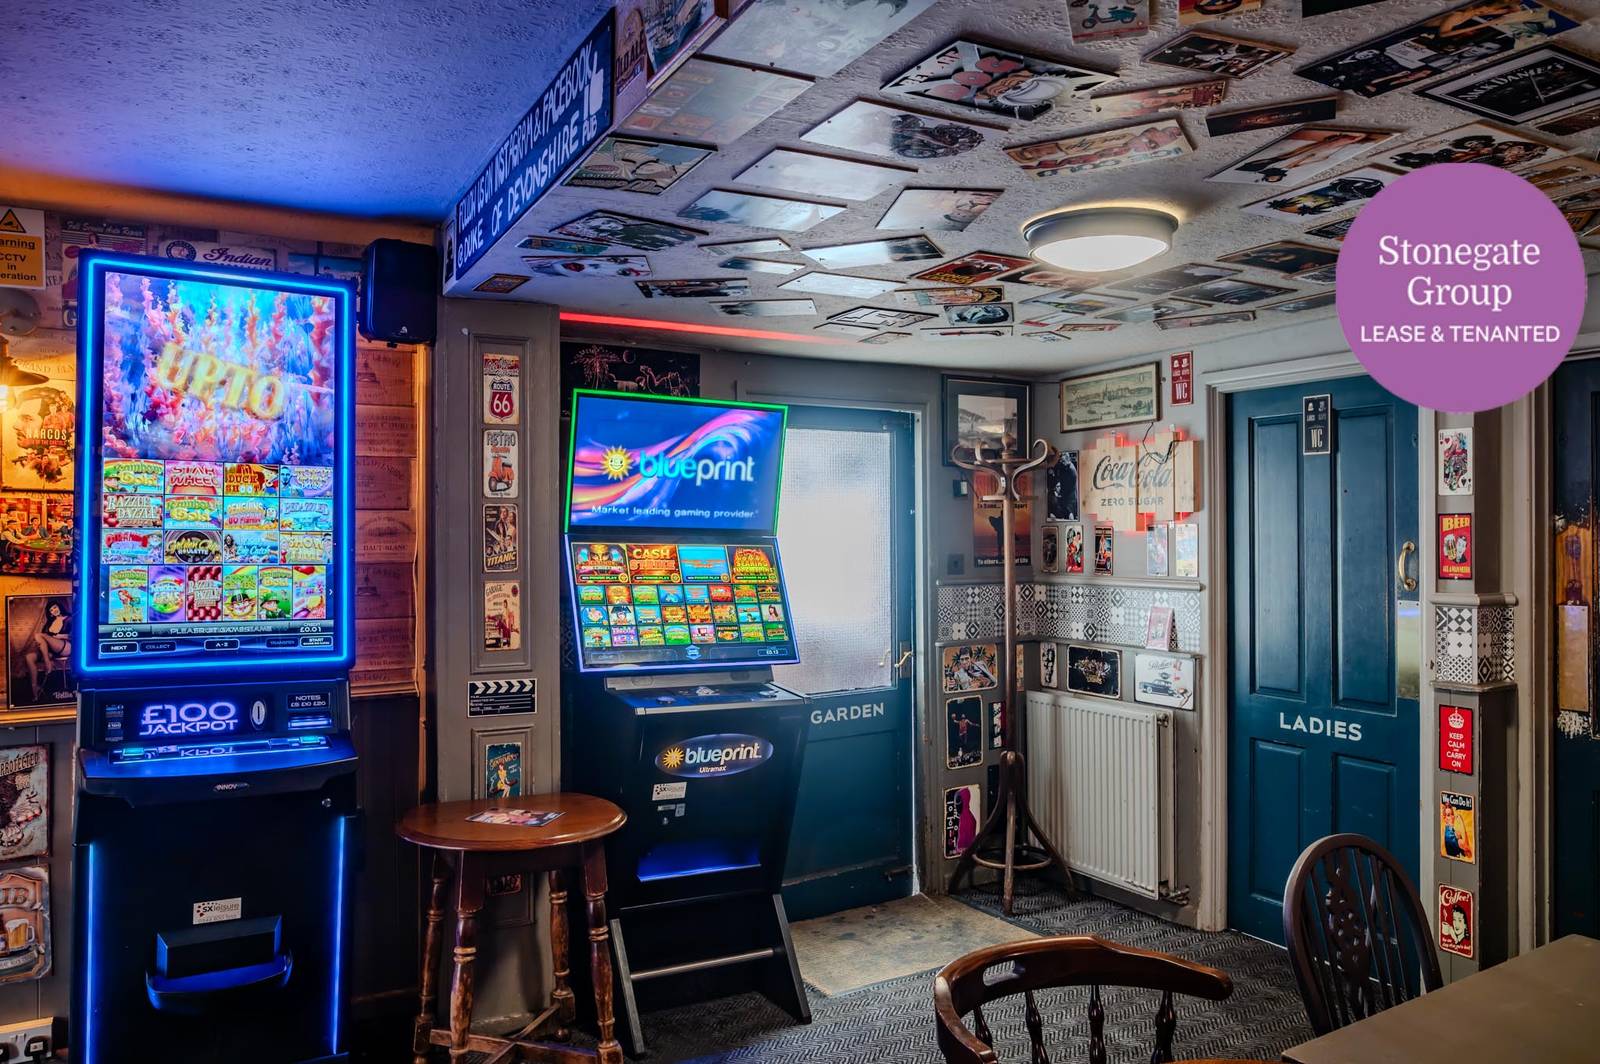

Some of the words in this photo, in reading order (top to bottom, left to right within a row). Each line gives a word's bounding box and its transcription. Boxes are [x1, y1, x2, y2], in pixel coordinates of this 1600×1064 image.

[494, 117, 532, 189] INSTAGRAM
[533, 111, 540, 141] &
[543, 41, 592, 136] FACEBOOK
[491, 198, 502, 237] OF
[507, 111, 579, 221] DEVONSHIRE
[583, 117, 597, 145] PUB
[0, 239, 36, 250] arning
[202, 246, 274, 268] Indian
[493, 383, 512, 391] ROUTE
[1175, 383, 1188, 400] WC
[493, 394, 511, 413] 66
[1311, 428, 1323, 448] WC
[639, 451, 755, 486] blueprint
[1100, 498, 1125, 506] ZERO
[1128, 496, 1165, 506] SUGAR
[592, 505, 630, 515] Market
[633, 506, 671, 517] leading
[675, 509, 710, 518] gaming
[1442, 517, 1471, 531] BEER
[487, 552, 516, 567] TITANIC
[633, 549, 670, 559] CASH
[140, 701, 237, 725] £100
[810, 702, 885, 724] GARDEN
[139, 719, 239, 736] JACKPOT
[1280, 712, 1362, 741] LADIES
[1449, 732, 1464, 740] KEEP
[1447, 740, 1465, 749] CALM
[685, 742, 762, 766] blueprint
[1446, 751, 1467, 760] CARRY
[699, 765, 727, 774] Ultramax
[1451, 760, 1462, 768] ON
